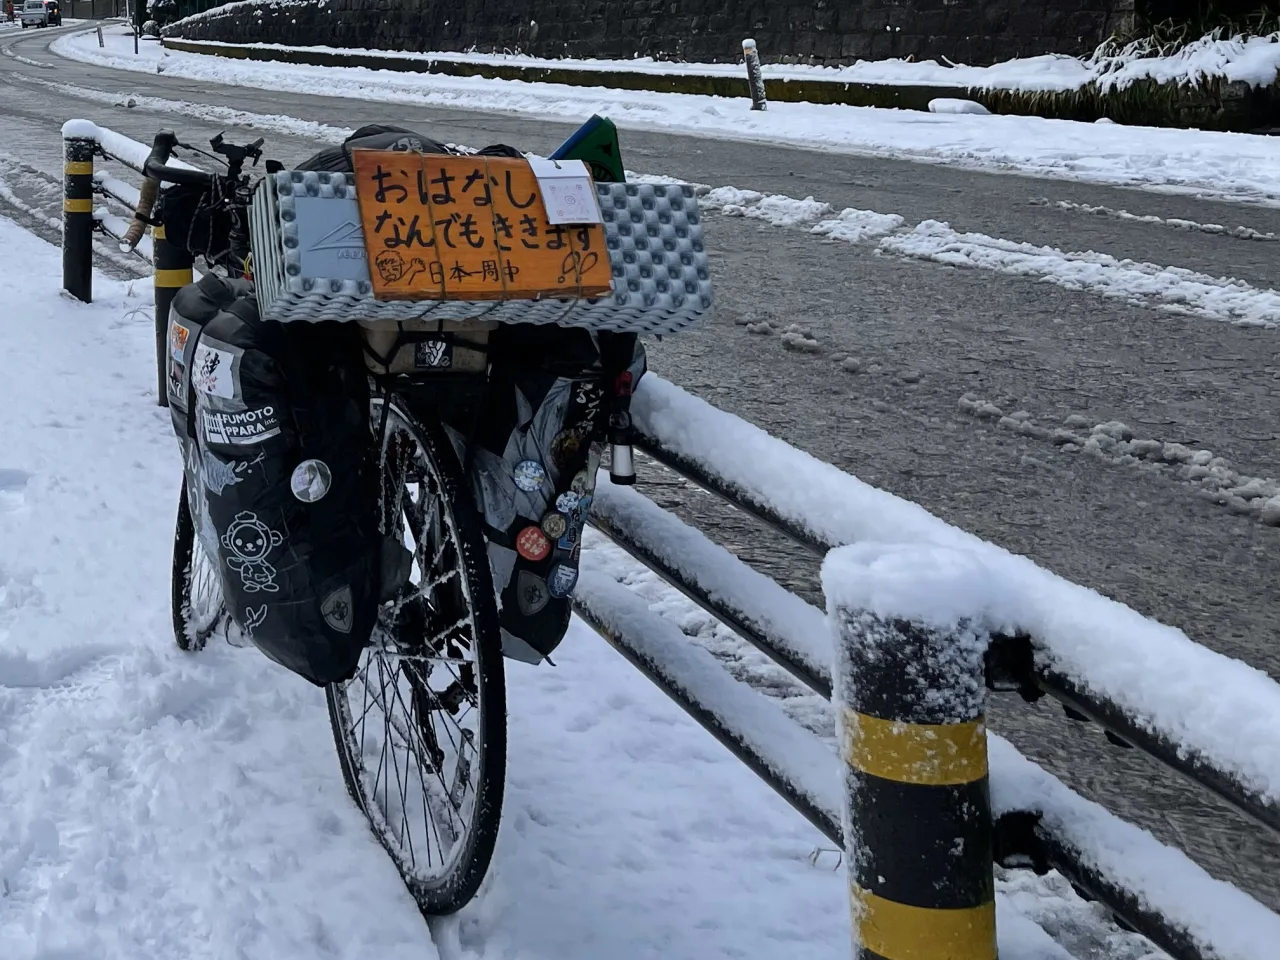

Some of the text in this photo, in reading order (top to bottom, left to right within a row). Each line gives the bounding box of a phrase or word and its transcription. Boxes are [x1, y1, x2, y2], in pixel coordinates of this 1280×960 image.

[371, 164, 537, 209] おはなし
[374, 209, 597, 252] なんでもききます
[429, 258, 520, 285] 日本一周中
[222, 406, 274, 424] FUMOTO
